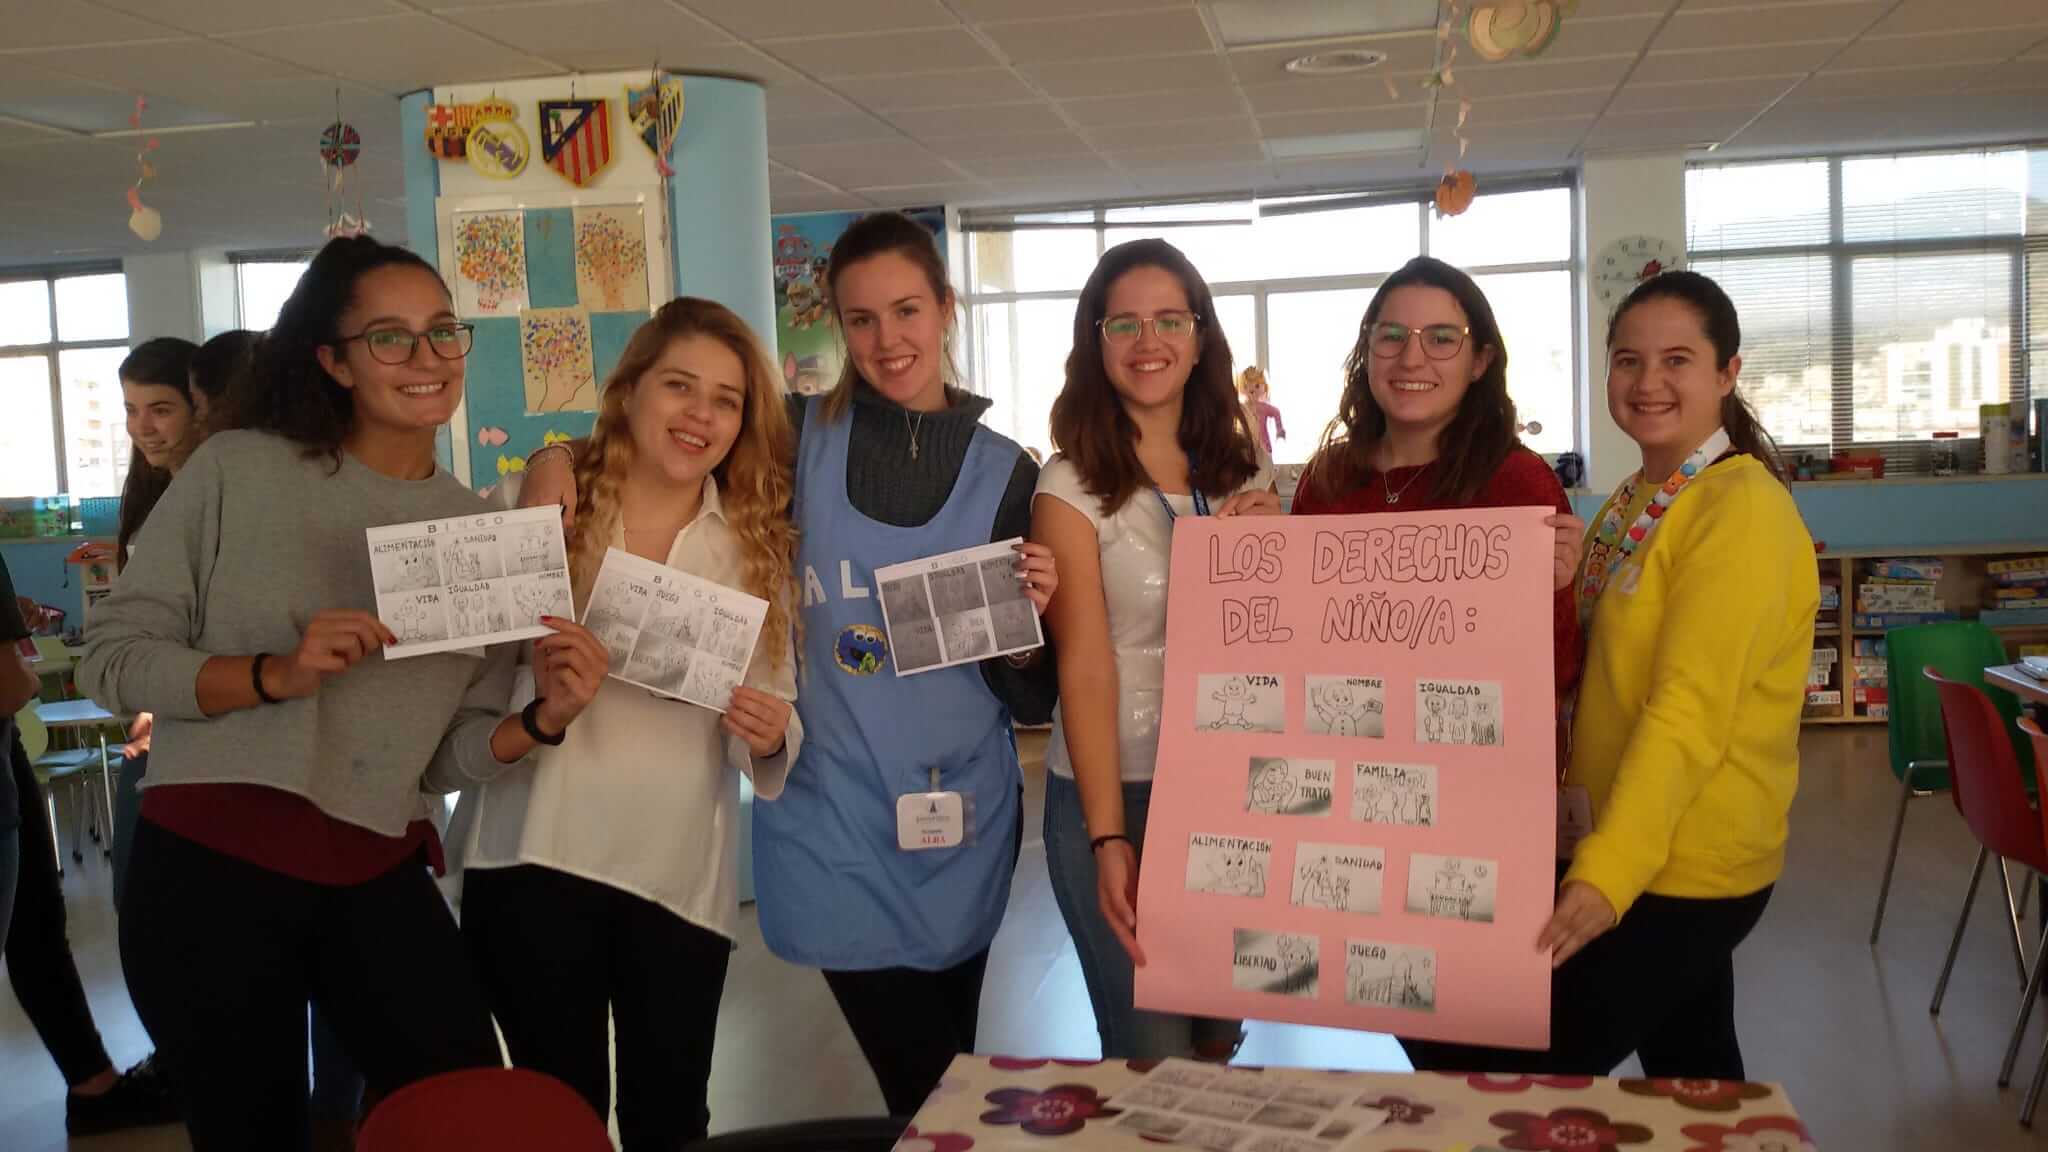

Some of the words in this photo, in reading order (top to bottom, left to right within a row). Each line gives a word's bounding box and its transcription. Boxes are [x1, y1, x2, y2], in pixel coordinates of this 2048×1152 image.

[1208, 531, 1286, 584] LOS
[1311, 523, 1511, 584] DERECHOS
[448, 582, 490, 595] IGUALDAD
[629, 583, 648, 597] VIDA
[415, 594, 440, 605] VIDA
[1222, 595, 1293, 645] DEL
[1245, 675, 1279, 688] VIDA
[1346, 677, 1384, 690] NOMBRE
[1418, 682, 1481, 696] IGUALDAD
[1304, 768, 1331, 782] BUEN
[1356, 763, 1406, 779] FAMILIA
[1301, 786, 1332, 801] TRATO
[1335, 855, 1383, 871] SANIDAD
[1350, 944, 1386, 960] JUEGO
[1233, 951, 1277, 971] LIBERTAD
